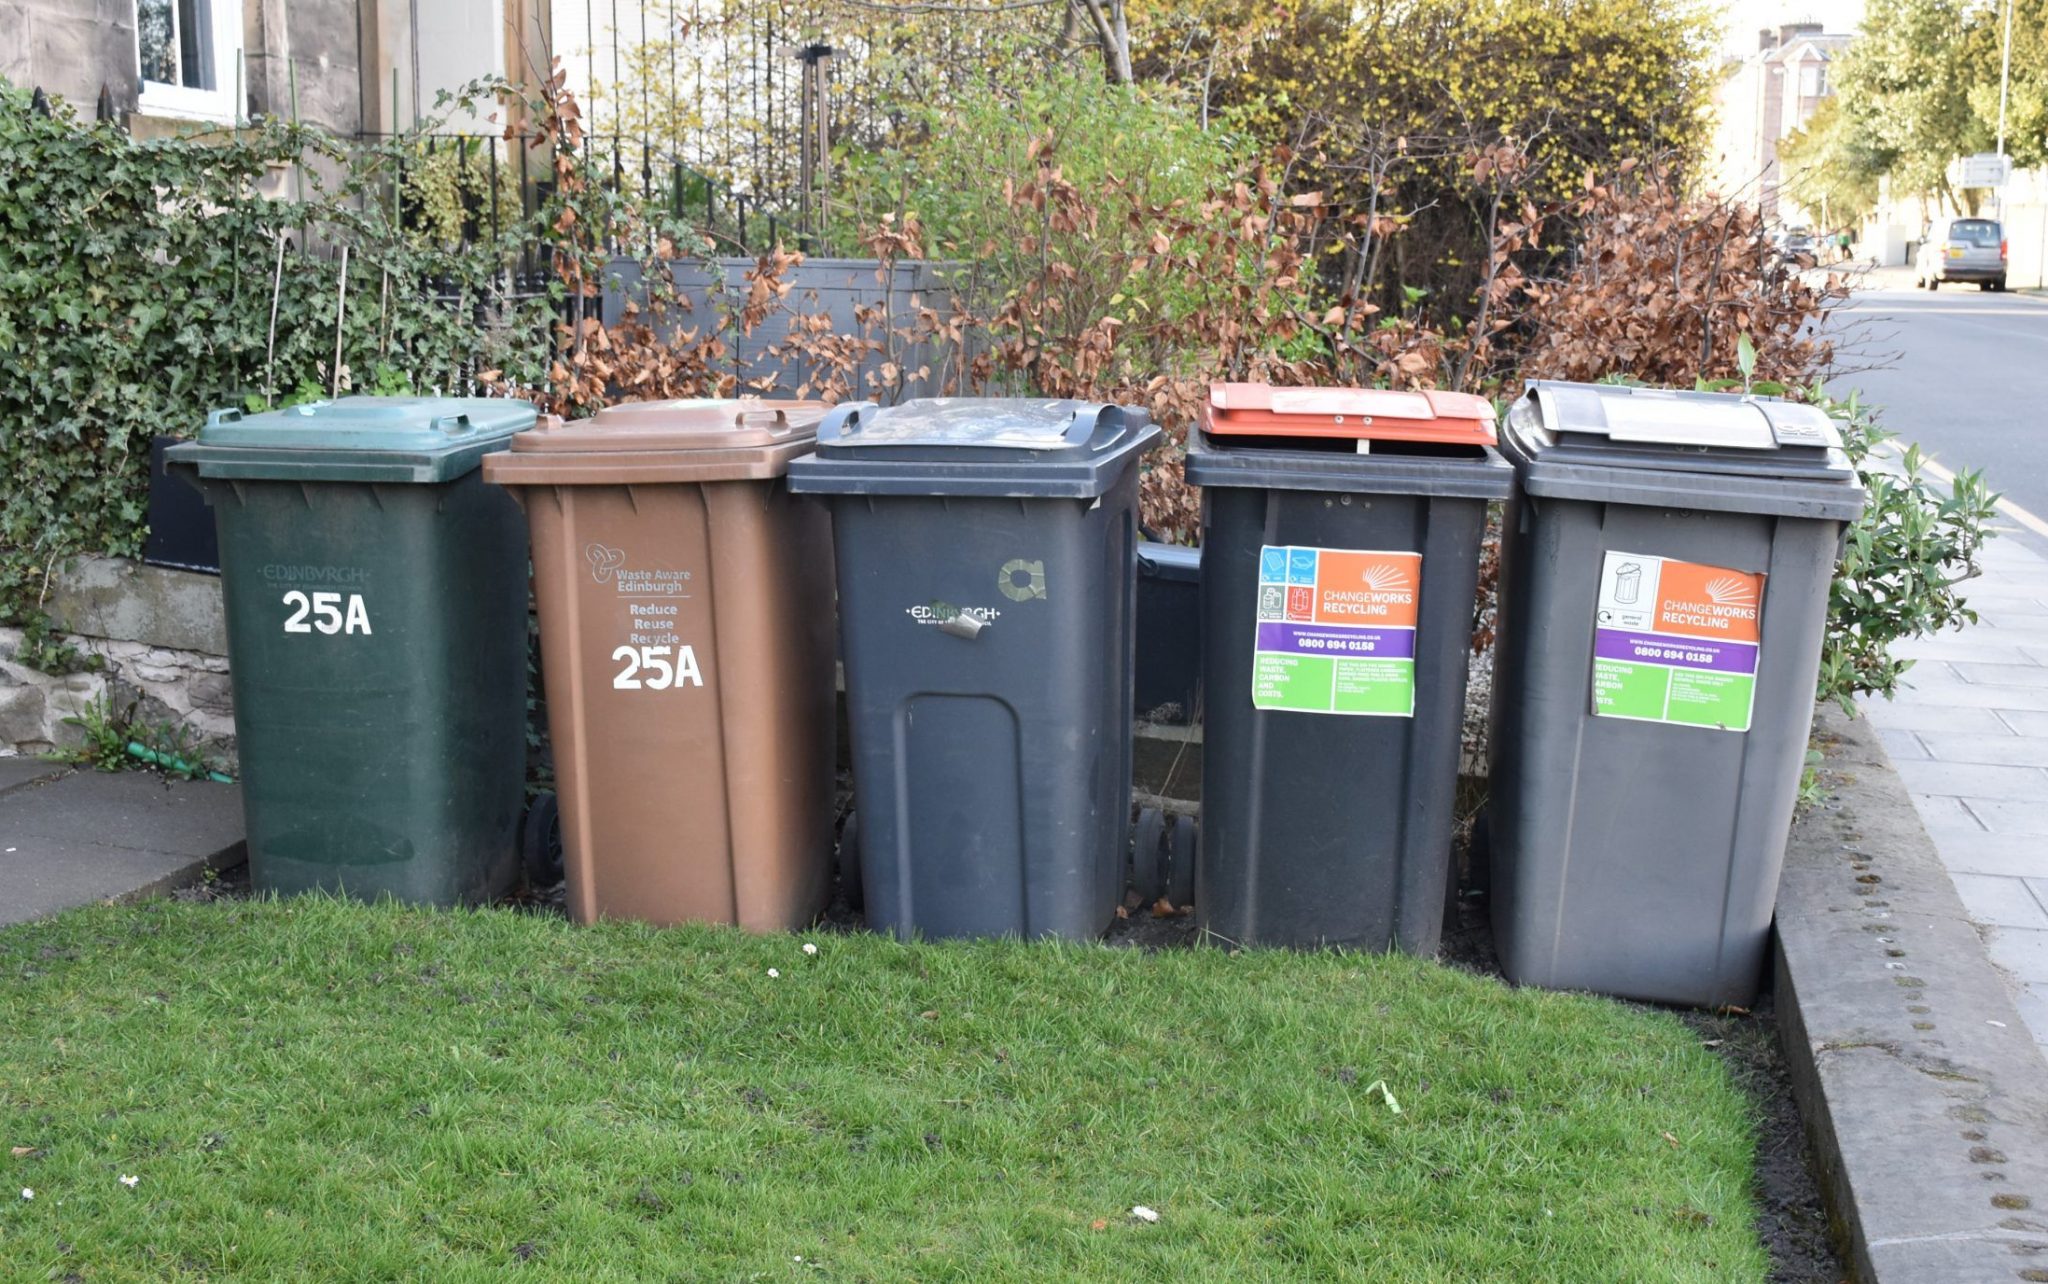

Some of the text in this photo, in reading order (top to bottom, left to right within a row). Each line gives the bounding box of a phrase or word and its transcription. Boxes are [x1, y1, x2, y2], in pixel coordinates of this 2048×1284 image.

[616, 570, 691, 580] Waste Aware
[617, 581, 682, 594] Edinburgh
[1324, 591, 1412, 604] CHANGEWORKS
[282, 590, 372, 635] 25A
[630, 603, 677, 615] Reduce
[1323, 602, 1387, 615] RECYCLING
[1664, 600, 1756, 619] CHANGEWORKS
[634, 619, 674, 629] Reuse
[1662, 613, 1728, 629] RECYCLING
[630, 633, 679, 646] Recycle
[1298, 638, 1375, 651] 0800 694 0158
[1634, 646, 1713, 663] 0800 694 0158
[612, 645, 704, 690] 25A
